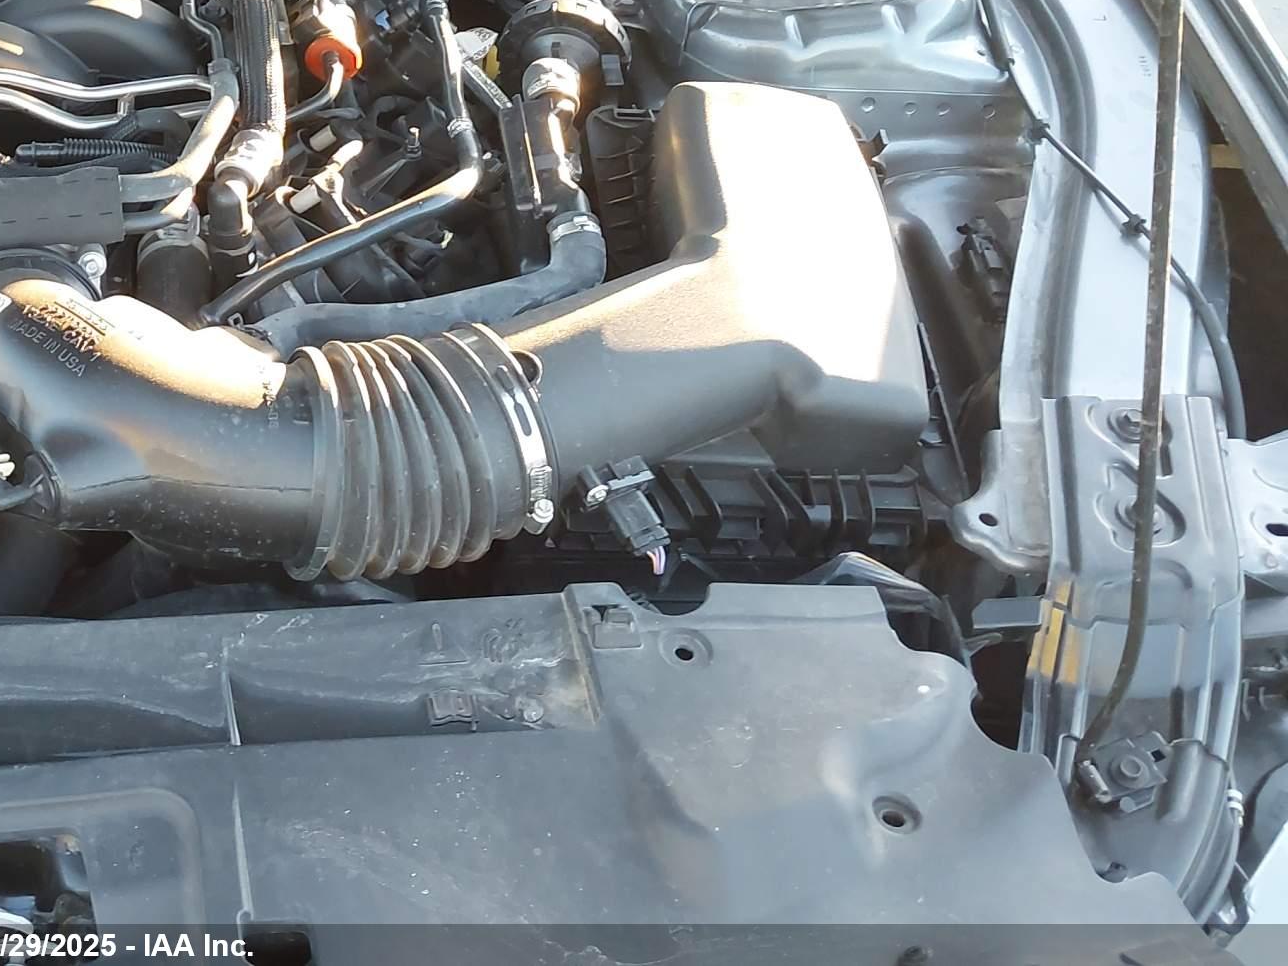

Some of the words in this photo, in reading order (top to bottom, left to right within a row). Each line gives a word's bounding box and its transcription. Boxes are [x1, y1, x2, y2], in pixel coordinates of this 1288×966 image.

[8, 317, 46, 343] MADE
[43, 338, 61, 354] IN
[58, 348, 86, 377] USA
